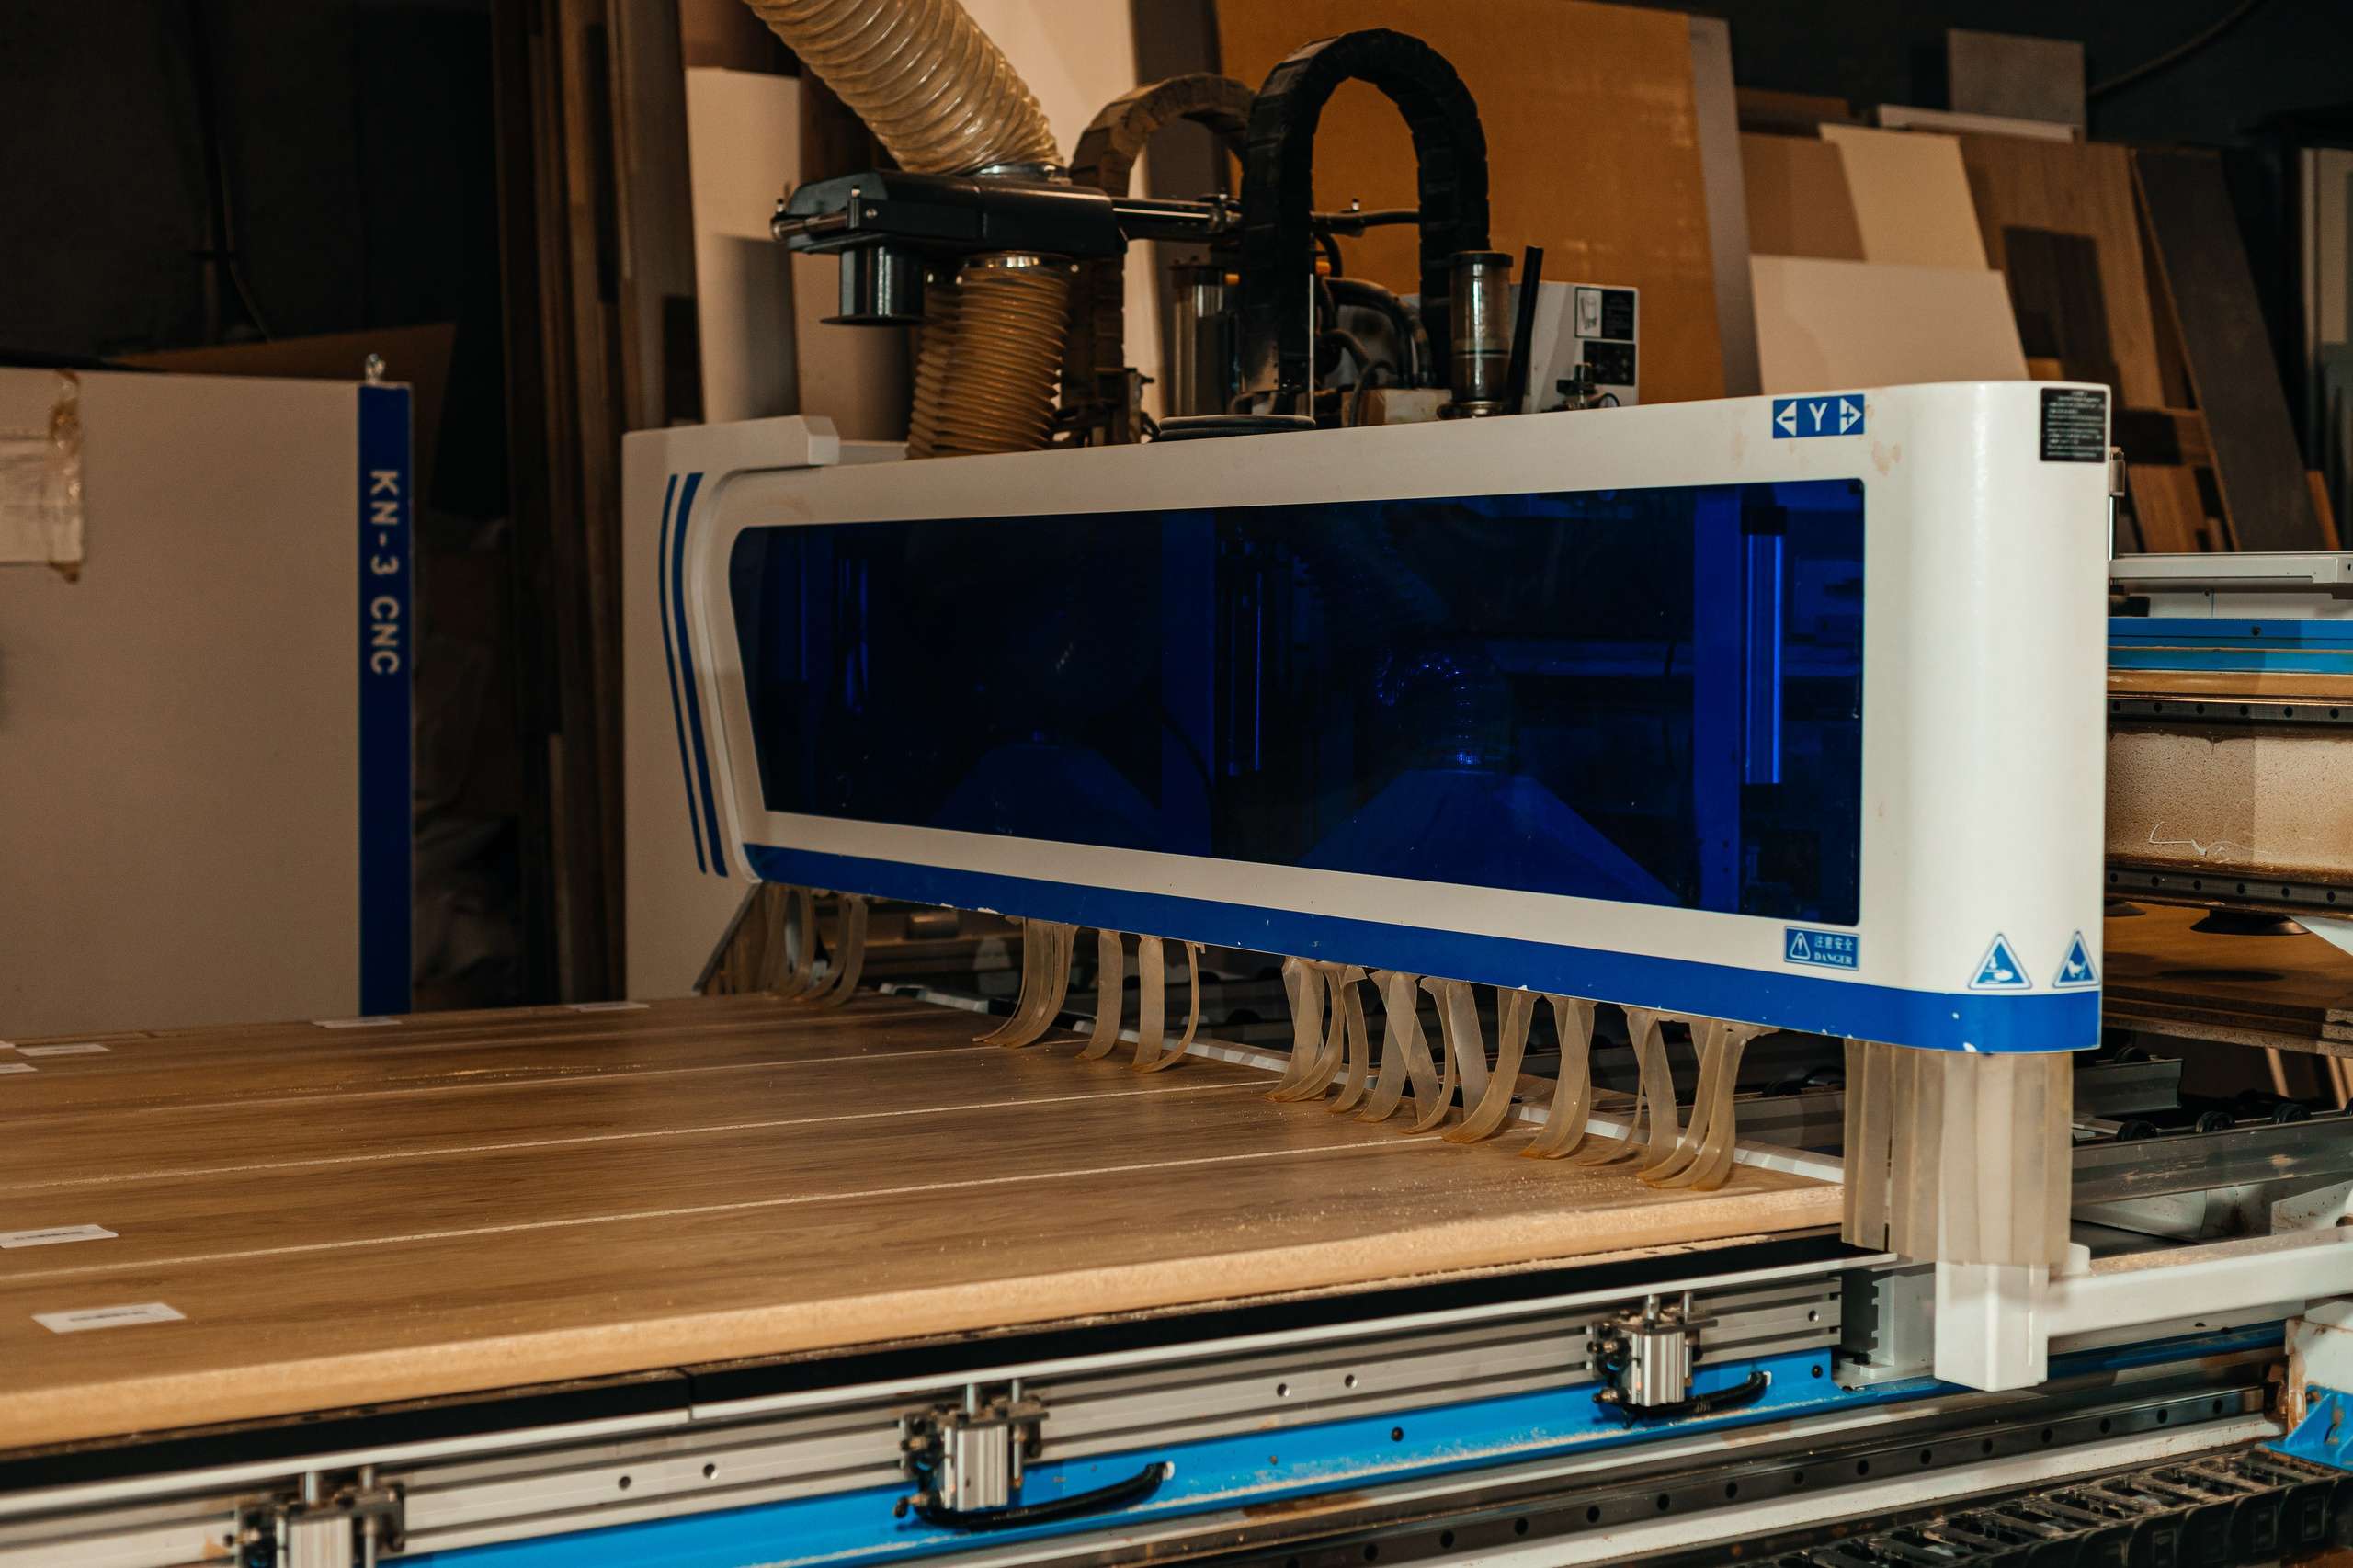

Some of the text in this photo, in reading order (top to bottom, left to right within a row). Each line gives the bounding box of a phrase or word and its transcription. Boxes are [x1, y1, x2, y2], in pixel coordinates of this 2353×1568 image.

[1808, 402, 1828, 432] Y
[369, 469, 401, 676] KN-3 CNC
[1814, 935, 1853, 952] 注意安全
[1814, 951, 1853, 965] DANGER
